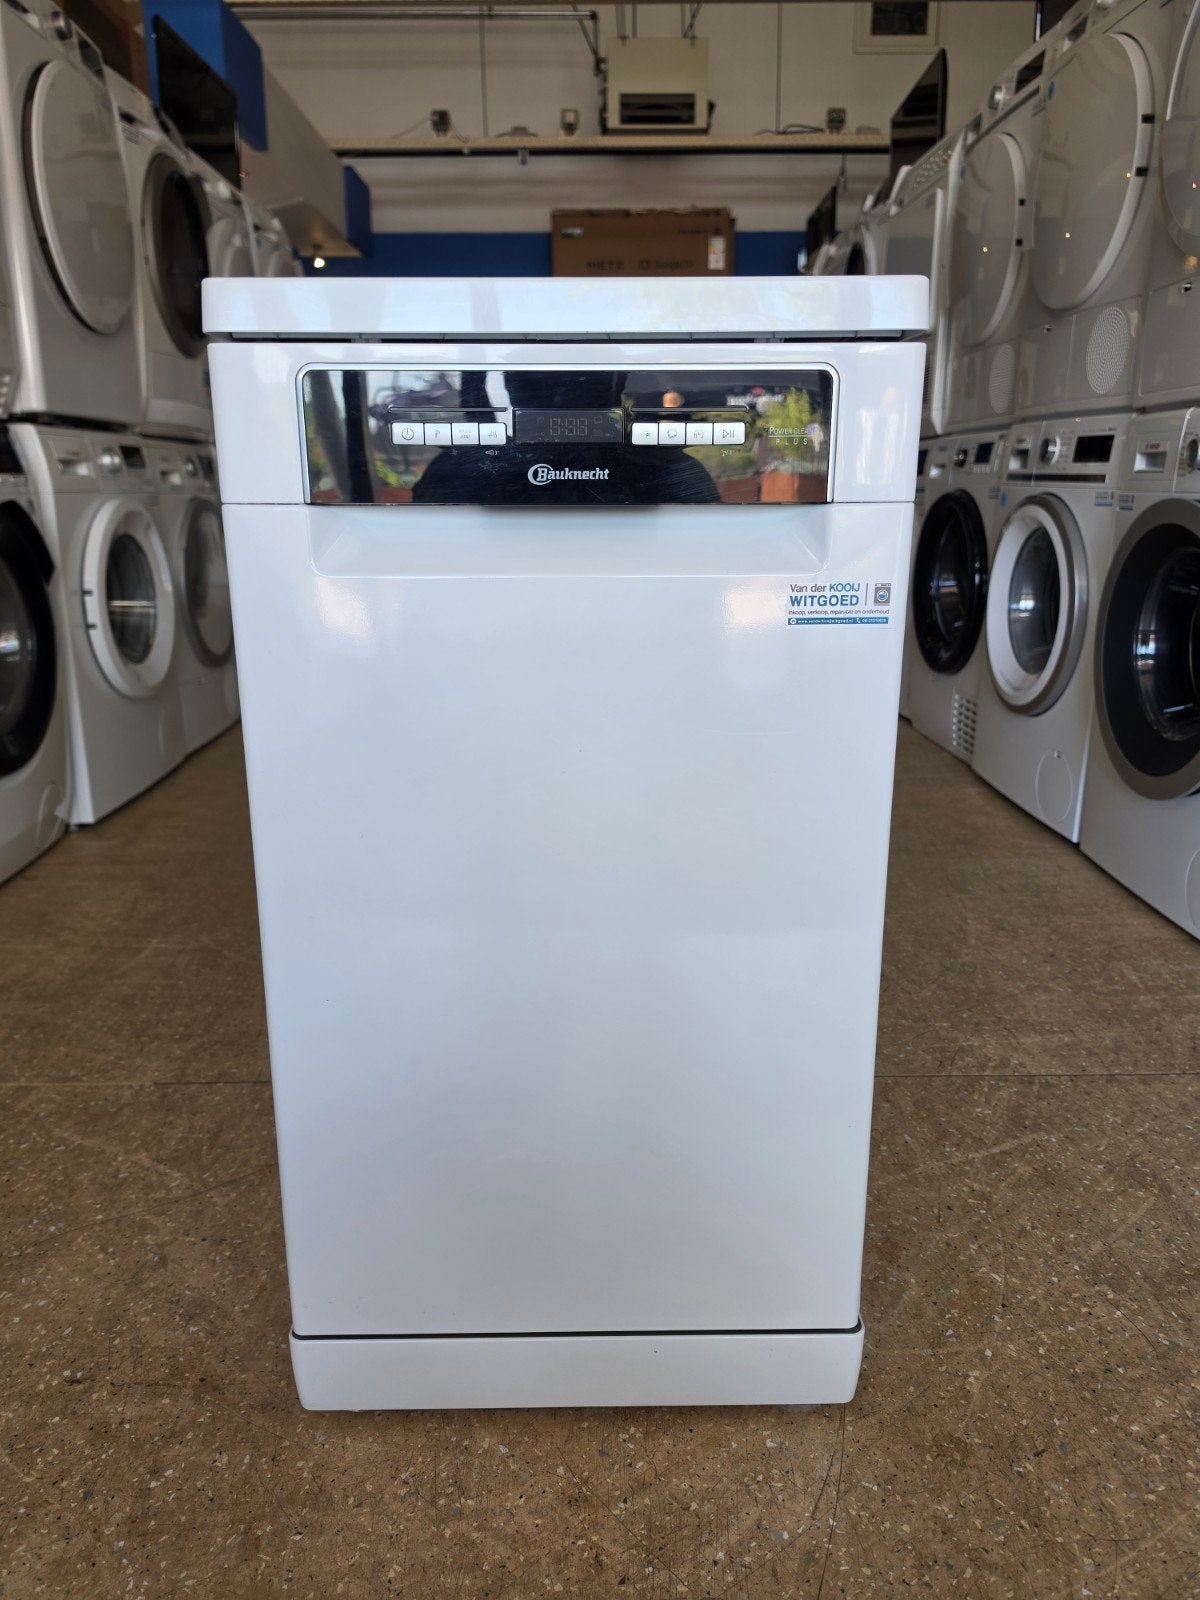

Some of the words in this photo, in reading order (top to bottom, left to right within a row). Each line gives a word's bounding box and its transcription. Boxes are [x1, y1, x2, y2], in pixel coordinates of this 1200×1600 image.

[528, 465, 609, 484] Bauknecht
[790, 583, 807, 592] Van
[810, 583, 827, 592] der
[829, 583, 860, 592] KOOIJ
[789, 595, 859, 606] WITGOED
